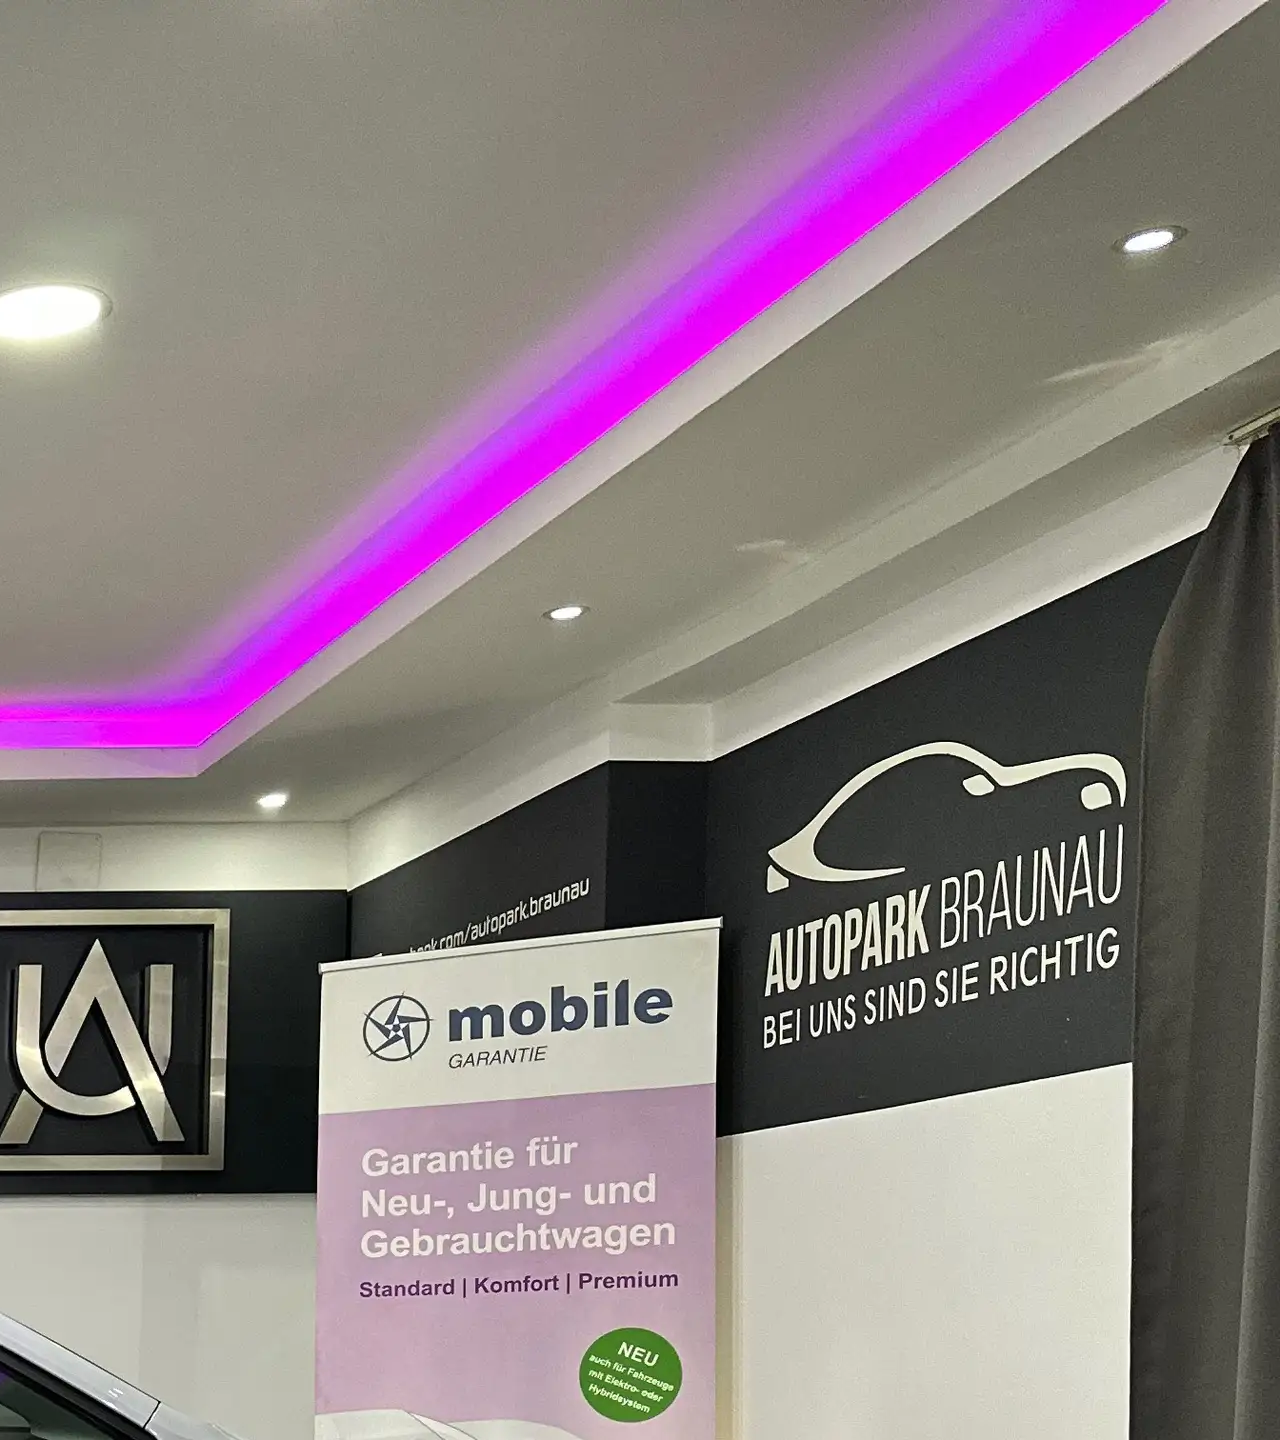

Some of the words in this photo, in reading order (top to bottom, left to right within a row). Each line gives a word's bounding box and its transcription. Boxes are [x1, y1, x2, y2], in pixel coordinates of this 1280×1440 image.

[765, 884, 931, 997] AUTOPARK
[940, 824, 1124, 949] BRAUNAU
[764, 1008, 800, 1049] BEI
[809, 994, 856, 1038] UNS
[863, 977, 926, 1026] SIND
[934, 962, 979, 1009] SIE
[989, 927, 1120, 995] RICHTIG
[448, 979, 673, 1042] mobile
[448, 1045, 548, 1069] GARANTIE
[361, 1141, 515, 1177] Garantie
[526, 1136, 578, 1167] für
[361, 1188, 455, 1219] Neu-,
[466, 1183, 571, 1214] Jung-
[584, 1173, 656, 1205] und
[360, 1219, 676, 1258] Gebrauchtwagen
[359, 1278, 455, 1298] Standard
[474, 1274, 559, 1294] Komfort
[578, 1270, 679, 1290] Premium
[589, 1354, 611, 1368] auch
[613, 1362, 626, 1374] für
[627, 1368, 674, 1392] Fahrzeuge
[618, 1341, 659, 1367] NEU
[588, 1369, 603, 1381] mit
[604, 1374, 640, 1393] Elektro-
[641, 1390, 663, 1403] oder
[589, 1384, 651, 1413] Hybridsystem
